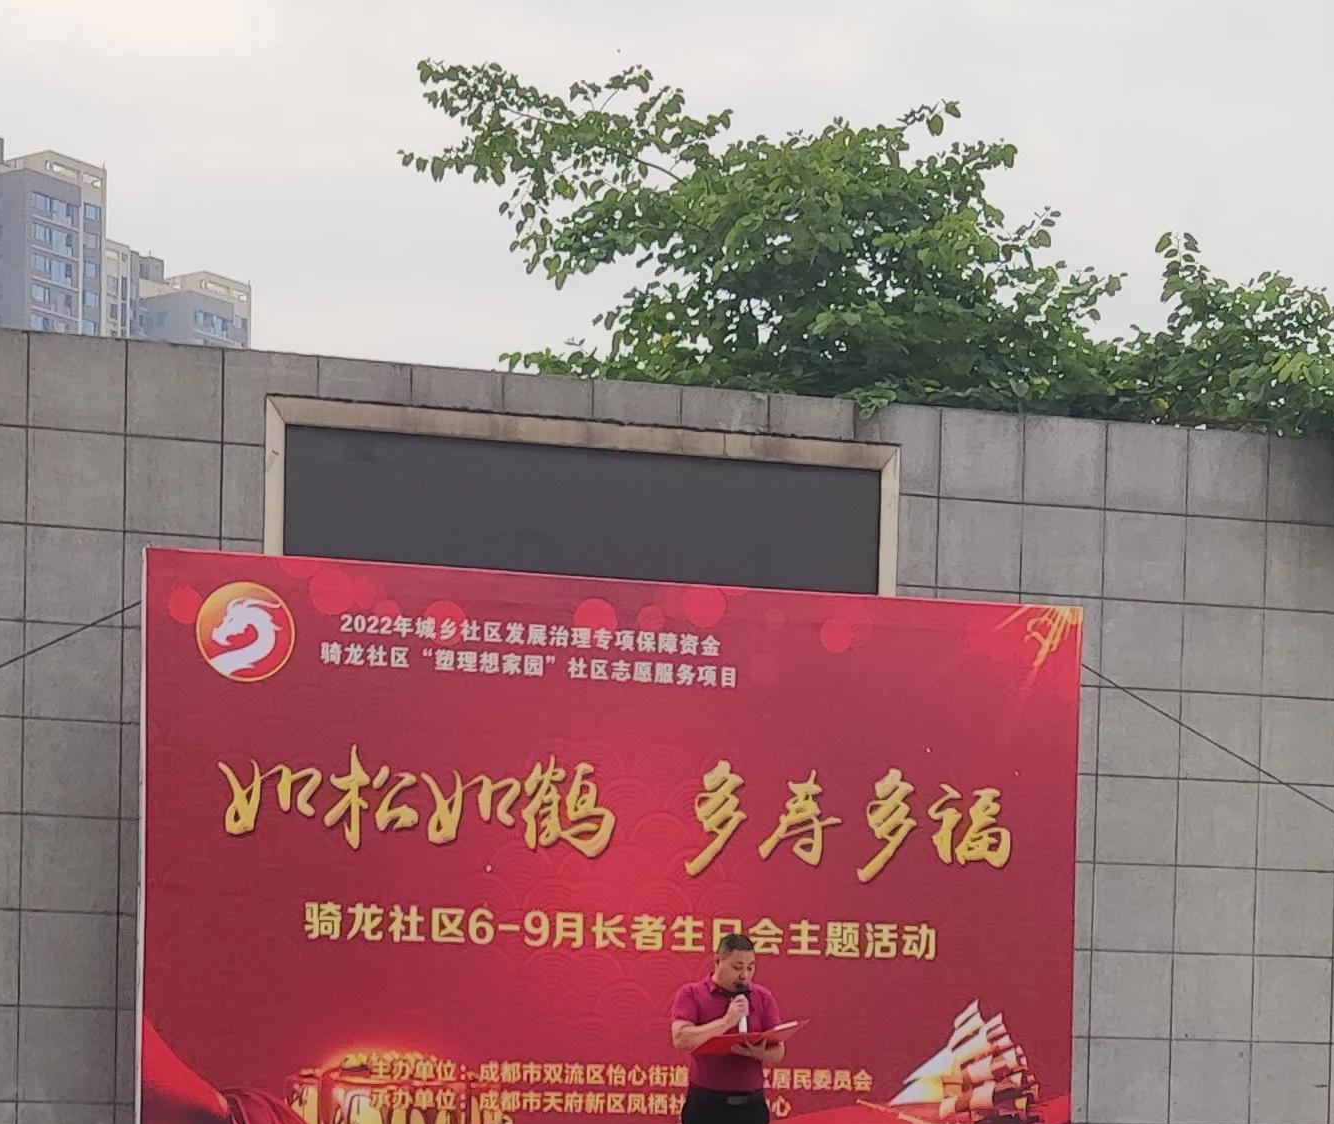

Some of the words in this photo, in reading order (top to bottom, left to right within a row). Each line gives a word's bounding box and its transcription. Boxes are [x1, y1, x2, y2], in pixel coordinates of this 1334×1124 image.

[339, 613, 722, 657] 2022年城乡社区发展治理专项保障资金
[217, 743, 616, 858] 如松如鹤
[684, 759, 1011, 882] 多寿多福
[303, 901, 937, 960] 骑龙社区6-9月长者生日会主题活动
